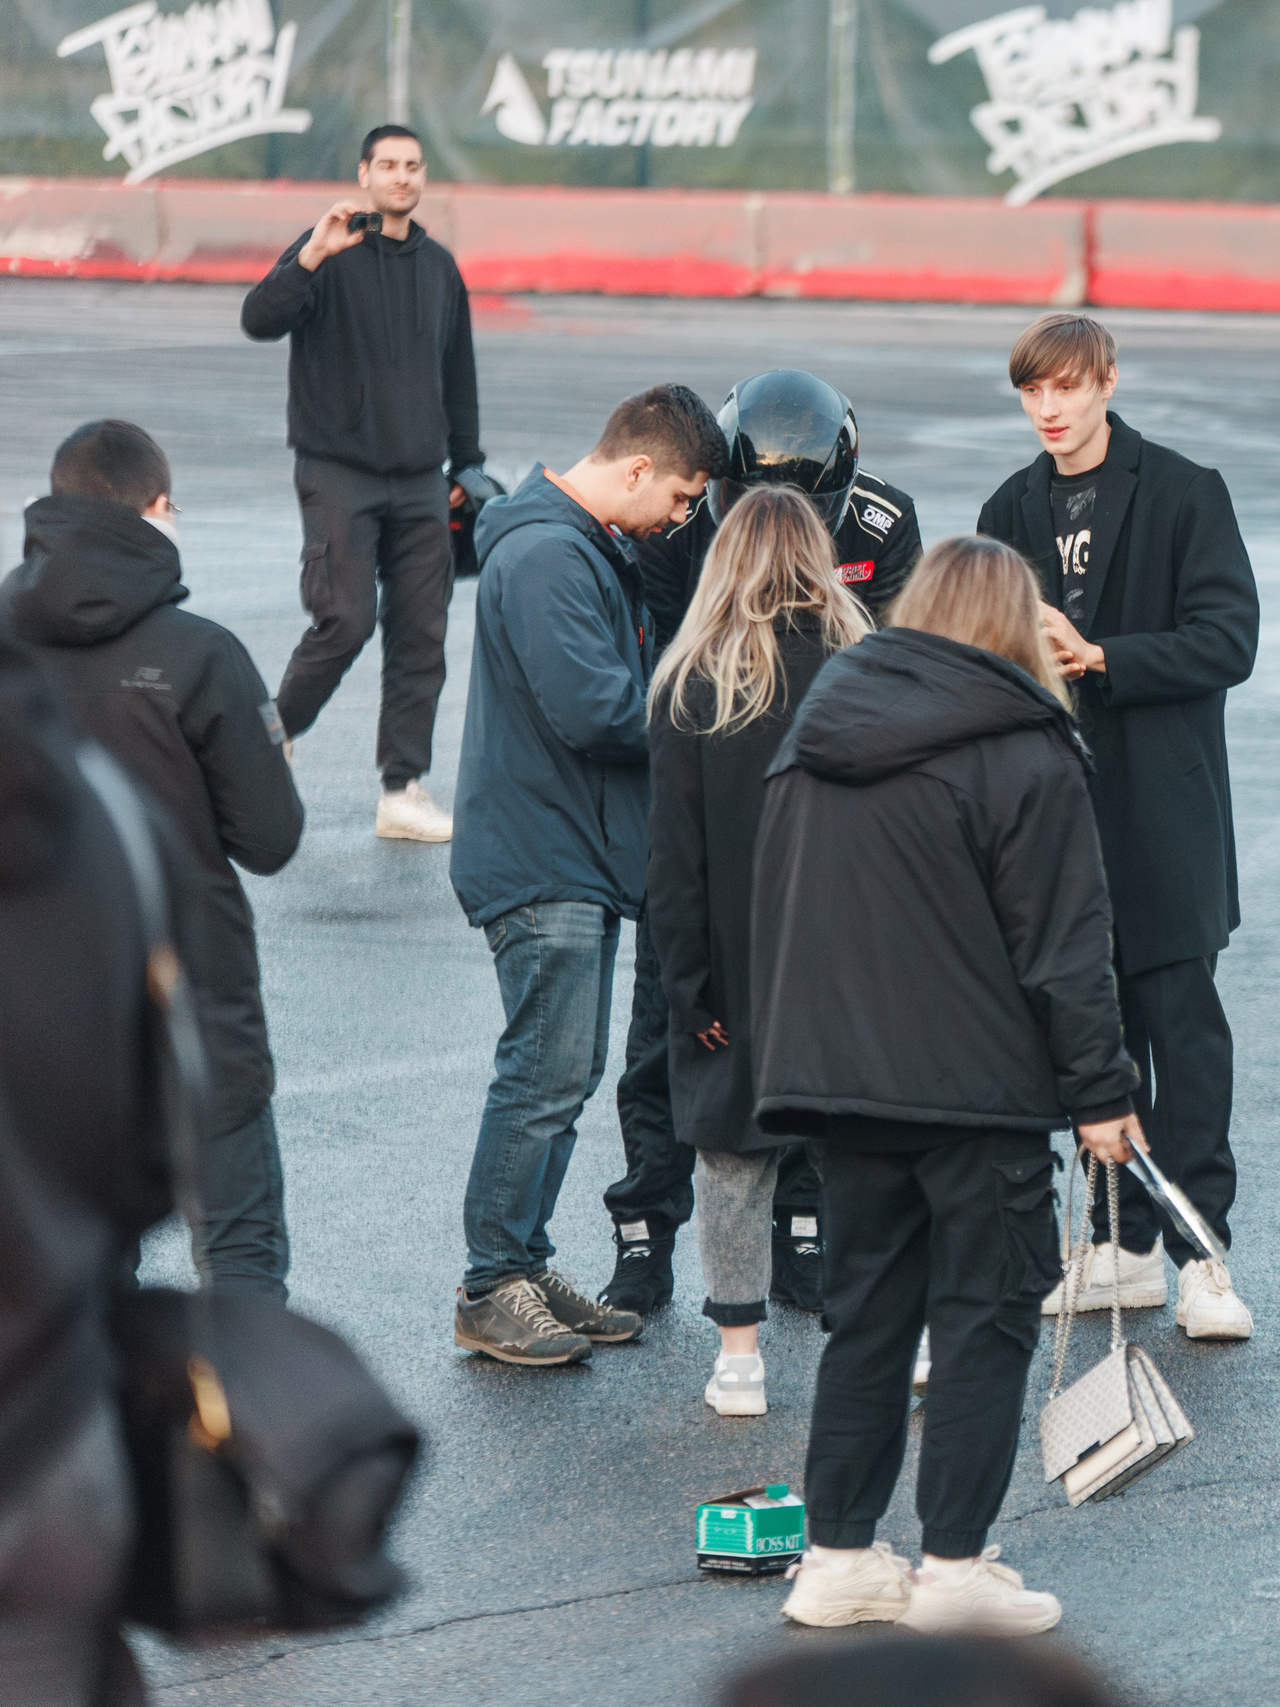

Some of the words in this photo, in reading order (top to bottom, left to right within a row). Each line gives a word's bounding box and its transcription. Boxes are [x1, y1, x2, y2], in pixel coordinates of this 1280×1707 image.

[542, 48, 757, 99] TSUNAMI
[545, 100, 756, 148] FACTORY
[863, 507, 893, 530] OMP
[756, 1536, 784, 1553] BOSS
[785, 1534, 802, 1550] KIT
